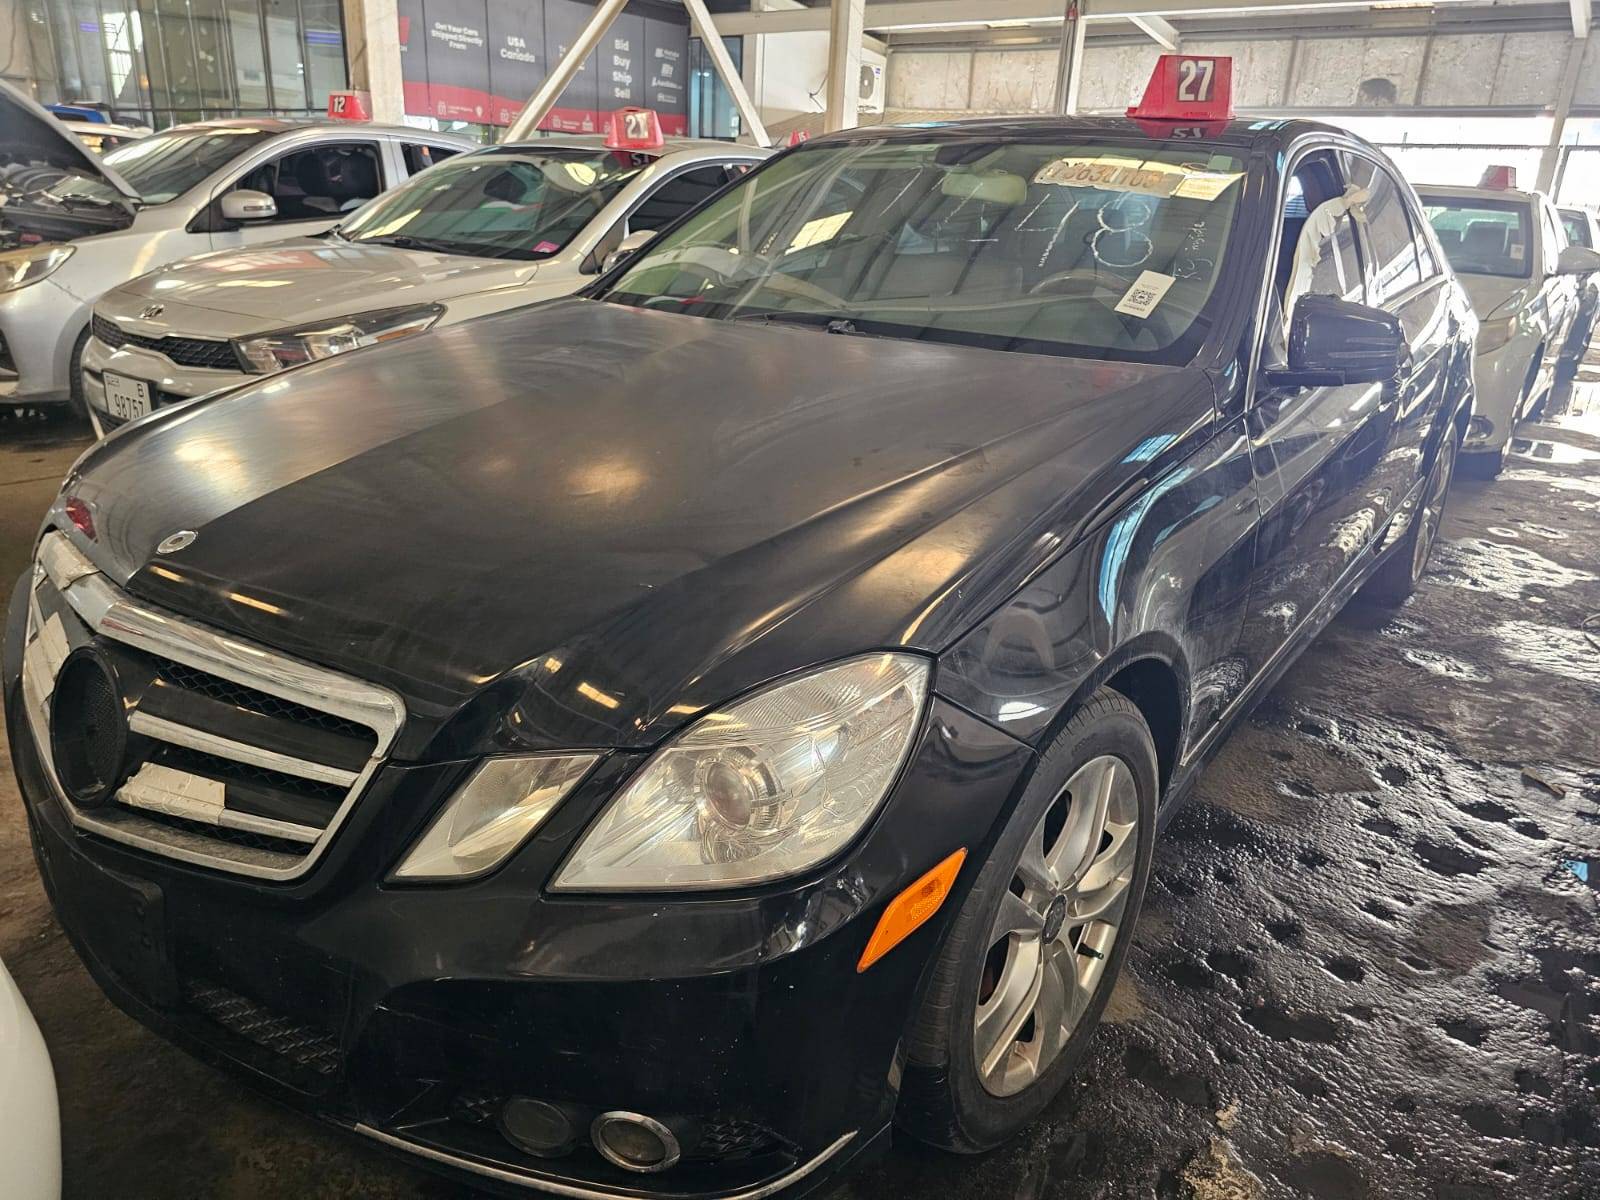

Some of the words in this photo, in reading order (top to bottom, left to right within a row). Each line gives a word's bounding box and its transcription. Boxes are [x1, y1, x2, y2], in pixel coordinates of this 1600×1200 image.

[507, 35, 526, 48] USA
[614, 38, 630, 52] Bid
[500, 47, 536, 64] Canada
[612, 54, 631, 71] Buy
[612, 70, 633, 87] Ship
[1179, 60, 1214, 101] 27
[613, 86, 631, 100] Sell
[333, 95, 346, 113] 12
[625, 113, 648, 139] 21
[137, 383, 145, 398] B
